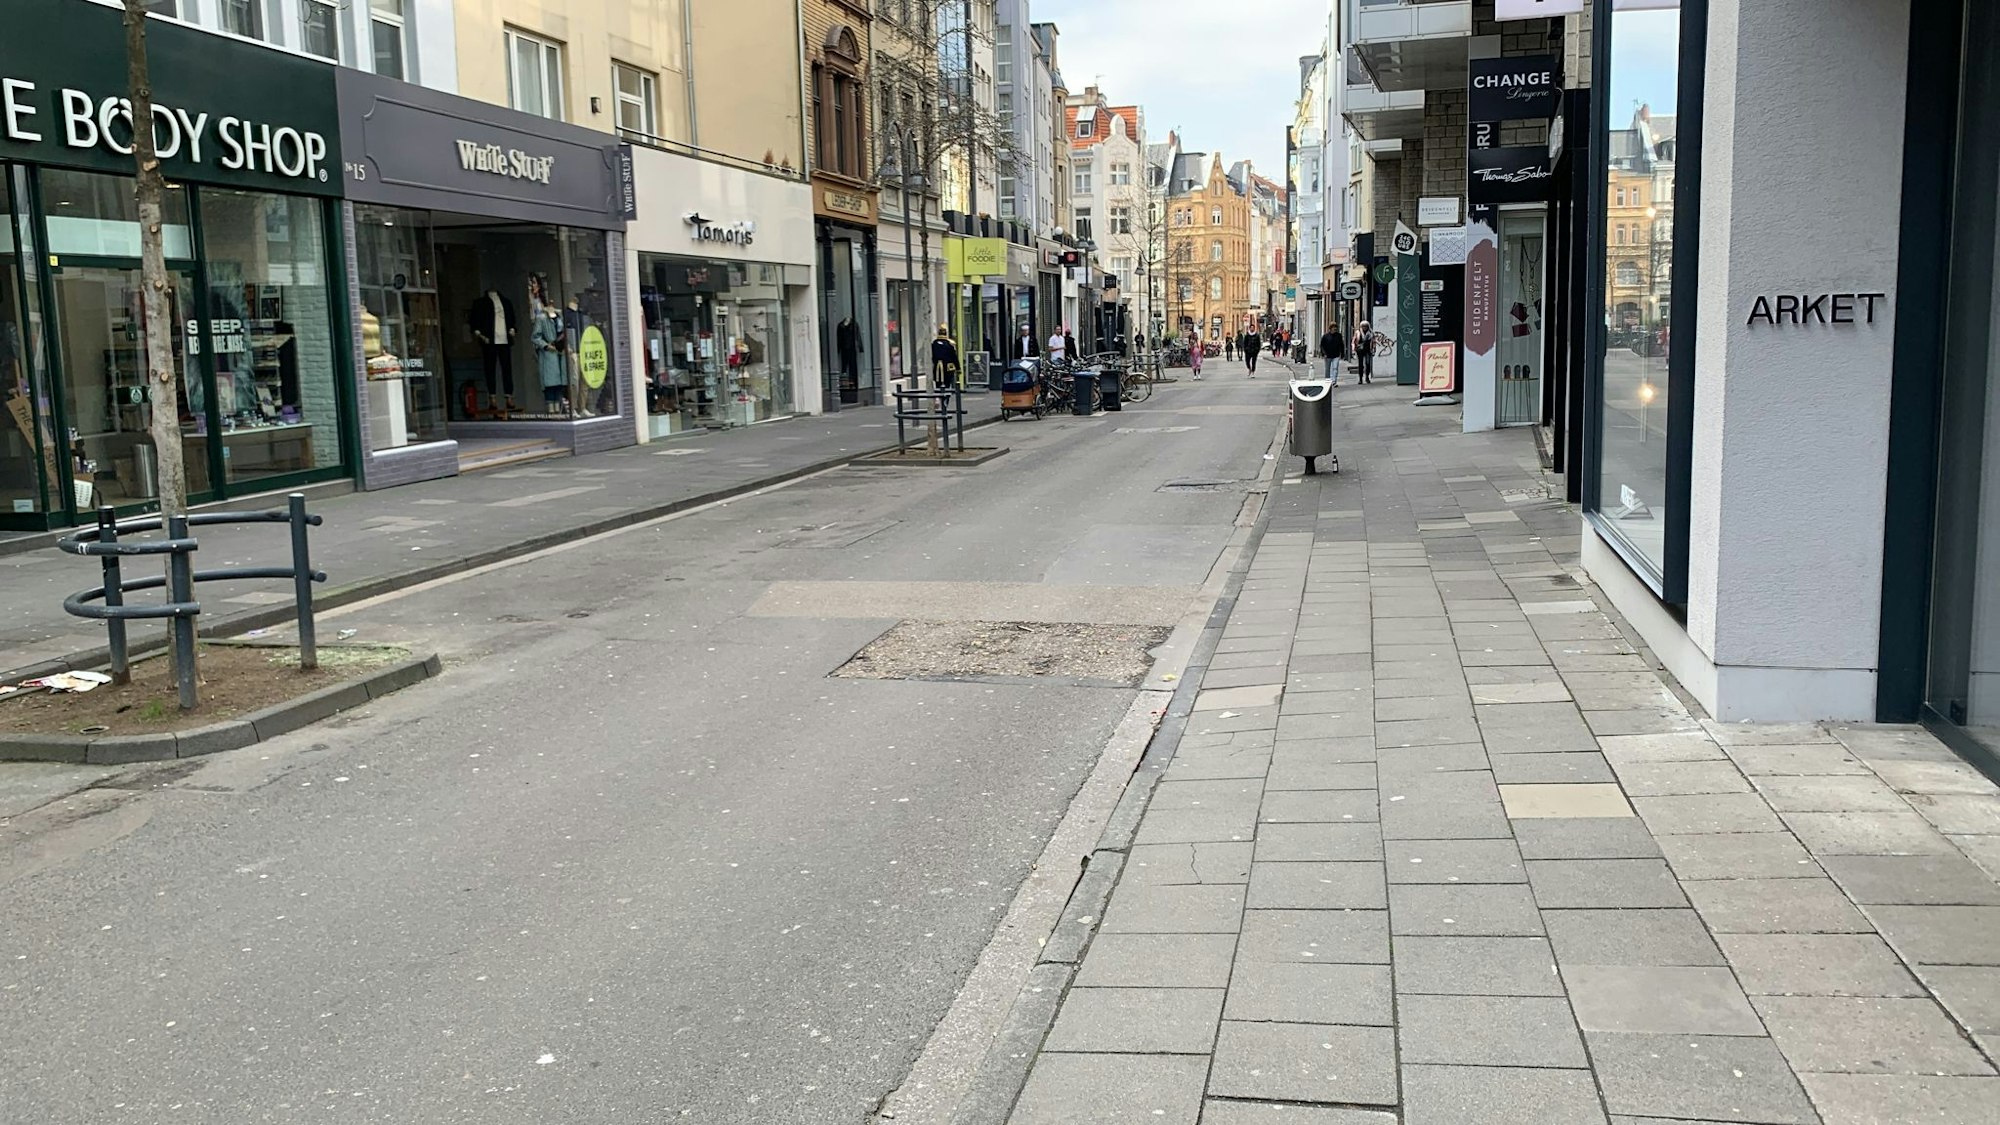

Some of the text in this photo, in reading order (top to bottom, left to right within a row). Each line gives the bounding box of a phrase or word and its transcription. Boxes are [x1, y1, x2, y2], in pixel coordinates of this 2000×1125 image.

[1473, 71, 1550, 89] CHANGE
[1506, 87, 1549, 102] Lingerie
[61, 88, 208, 163] BODY
[354, 163, 366, 181] 15
[1472, 165, 1552, 183] Thomas Sabo
[682, 212, 753, 245] Tamaris
[967, 255, 996, 263] FOODIE
[1472, 261, 1482, 335] SEIDENFELT
[1746, 293, 1886, 325] ARKET
[186, 319, 245, 334] SEEP.
[1431, 362, 1444, 374] for
